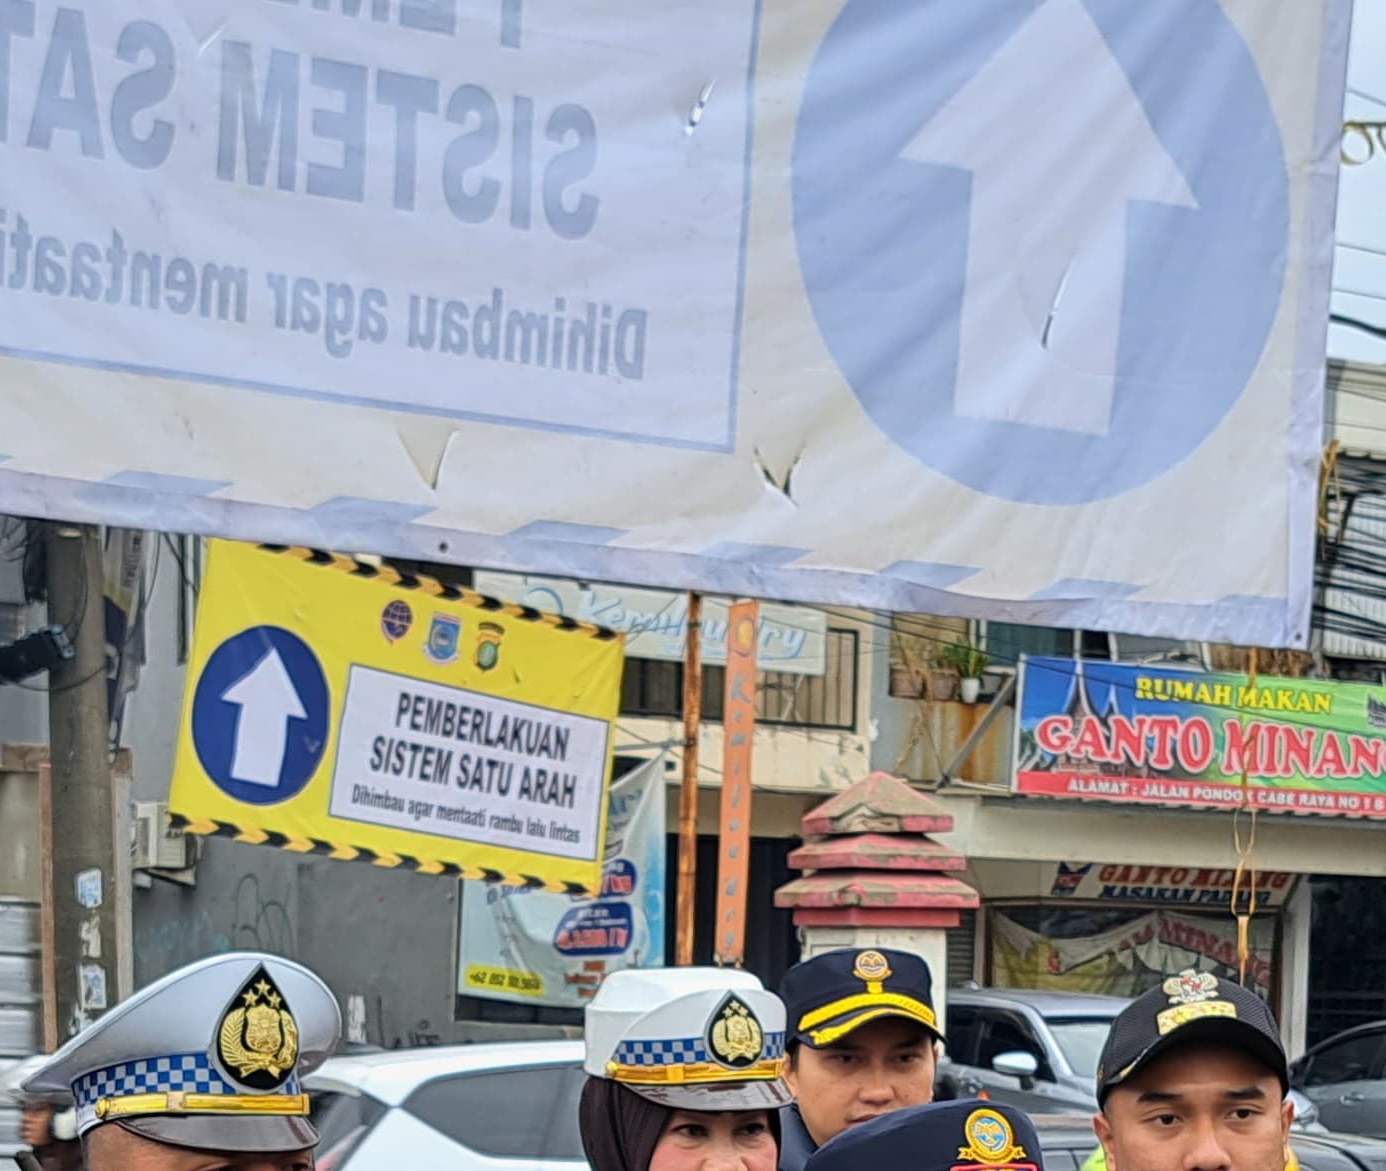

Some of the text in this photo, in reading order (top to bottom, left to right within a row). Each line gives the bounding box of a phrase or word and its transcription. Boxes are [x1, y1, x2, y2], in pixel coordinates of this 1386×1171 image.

[1136, 677, 1332, 714] RUMAH MAKAN
[395, 692, 571, 762] PEMBERLAKUAN
[1034, 714, 1213, 774] GANTO
[370, 736, 577, 809] SISTEM SATU ARAH
[1068, 780, 1129, 795] ALAMAT
[1141, 783, 1190, 799] JALAN
[1258, 791, 1295, 807] CABE
[1299, 793, 1333, 808] RAYA
[1337, 796, 1359, 809] NO
[352, 784, 580, 844] Dihimbau agar mentaati rambu lalu lintas
